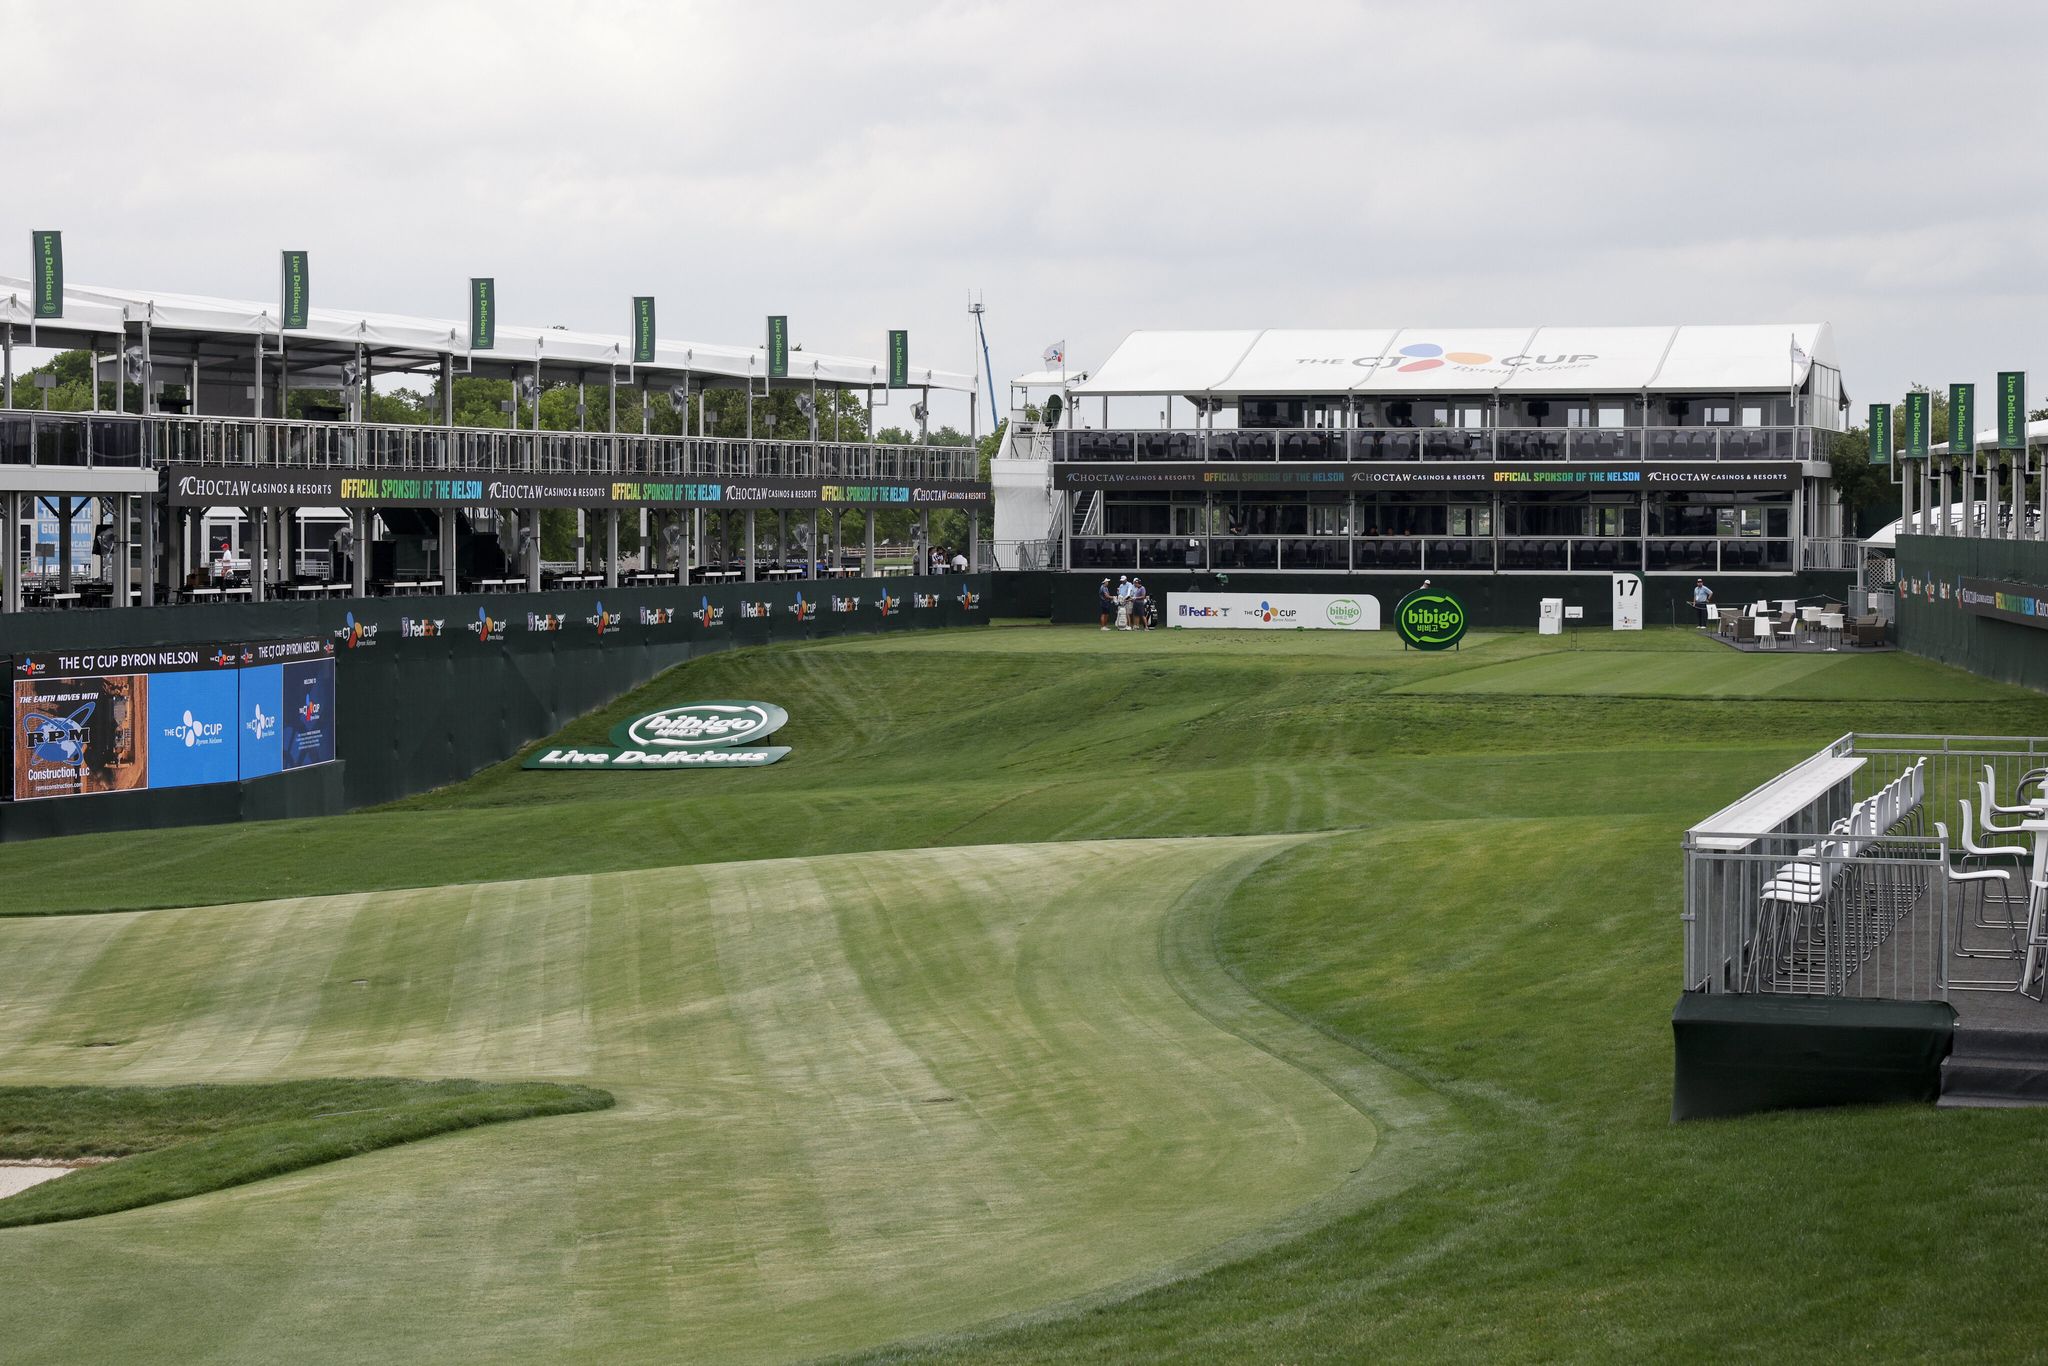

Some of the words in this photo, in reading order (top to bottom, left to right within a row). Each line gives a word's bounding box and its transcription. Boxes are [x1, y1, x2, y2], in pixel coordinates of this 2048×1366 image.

[44, 236, 52, 255] Live
[293, 275, 301, 314] Delicious
[1352, 356, 1407, 369] CJ
[1501, 354, 1599, 367] CUP
[1452, 365, 1513, 375] Byron
[1517, 364, 1591, 374] Nelson
[2007, 376, 2015, 393] Live
[2007, 395, 2016, 434] Delicious
[1957, 405, 1965, 440] Delicious
[1073, 472, 1124, 482] CHOCTAW
[1204, 472, 1240, 482] OFFICIAL
[1242, 472, 1280, 482] SPONSOR
[1283, 472, 1293, 482] OF
[1295, 472, 1310, 482] THE
[1313, 472, 1344, 482] NELSON
[1358, 472, 1411, 482] CHOCTAW
[1494, 472, 1532, 482] OFFICIAL
[1533, 472, 1573, 482] SPONSOR
[1576, 472, 1587, 482] OF
[1589, 472, 1605, 482] THE
[1607, 472, 1640, 482] NELSON
[1654, 472, 1710, 481] CHOCTAW
[186, 476, 250, 496] CHOCTAW
[251, 483, 287, 494] CASINOS
[289, 484, 295, 494] &
[297, 484, 332, 494] RESORTS
[341, 479, 378, 499] OFFICIAL
[381, 479, 420, 499] SPONSOR
[423, 480, 433, 499] OF
[435, 480, 449, 499] THE
[452, 481, 483, 499] NELSON
[494, 482, 544, 499] CHOCTAW
[544, 487, 572, 497] CASINOS
[573, 487, 577, 497] &
[578, 487, 605, 497] RESORTS
[612, 483, 641, 500] OFFICIAL
[643, 483, 673, 500] SPONSOR
[675, 484, 683, 500] OF
[684, 484, 696, 500] THE
[697, 484, 721, 500] NELSON
[731, 486, 768, 500] CHOCTAW
[768, 489, 790, 498] CASINOS
[791, 490, 794, 498] &
[795, 490, 817, 499] RESORTS
[822, 486, 846, 501] OFFICIAL
[847, 486, 871, 501] SPONSOR
[872, 486, 879, 501] OF
[880, 487, 889, 502] THE
[890, 487, 910, 502] NELSON
[916, 487, 947, 501] CHOCTAW
[947, 491, 964, 500] CASINOS
[965, 492, 968, 500] &
[968, 492, 986, 500] RESORTS
[1617, 580, 1638, 596] 17
[747, 602, 765, 618] FedEx
[807, 603, 816, 613] CUP
[837, 598, 853, 612] FedEx
[1189, 607, 1218, 617] FedEx
[1330, 606, 1359, 618] bibigo
[646, 609, 666, 625] FedEx
[714, 608, 724, 618] CUP
[1254, 609, 1263, 618] CJ
[1408, 608, 1459, 629] bibigo
[410, 619, 435, 637] FedEx
[475, 621, 482, 635] CJ
[493, 621, 506, 632] CUP
[535, 614, 557, 631] FedEx
[593, 615, 599, 627] CJ
[609, 616, 620, 625] CUP
[342, 628, 350, 641] CJ
[363, 626, 377, 638] CUP
[259, 646, 268, 658] THE
[269, 646, 275, 659] CJ
[275, 645, 285, 657] CUP
[286, 643, 302, 656] BYRON
[302, 641, 320, 654] NELSON
[59, 657, 80, 669] THE
[82, 656, 94, 671] CJ
[97, 655, 118, 668] CUP
[121, 654, 156, 667] BYRON
[159, 652, 198, 665] NELSON
[33, 695, 55, 703] EARTH
[57, 693, 80, 702] MOVES
[82, 692, 100, 700] WITH
[265, 716, 275, 727] CUP
[645, 715, 757, 735] bibigo
[27, 727, 91, 748] RPM
[164, 728, 175, 737] THE
[175, 725, 187, 740] CJ
[203, 723, 223, 735] CUP
[539, 750, 609, 764] Live
[612, 750, 769, 765] Delicious
[28, 766, 78, 781] Construction,
[79, 767, 90, 777] LLC
